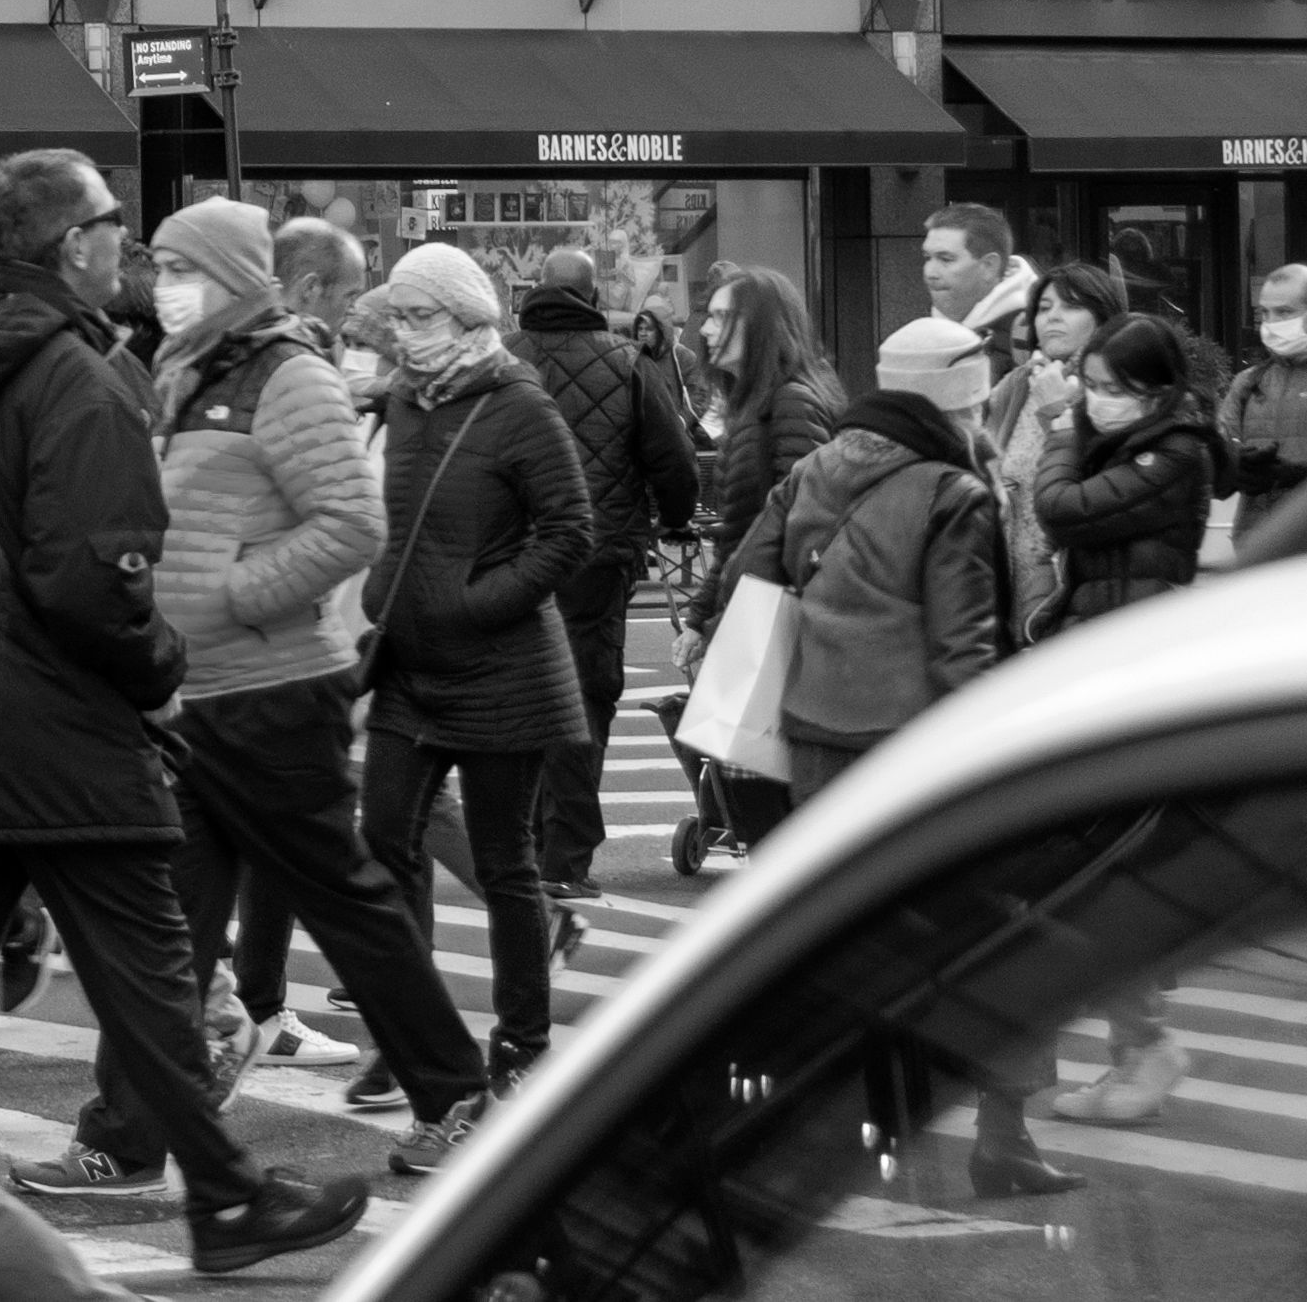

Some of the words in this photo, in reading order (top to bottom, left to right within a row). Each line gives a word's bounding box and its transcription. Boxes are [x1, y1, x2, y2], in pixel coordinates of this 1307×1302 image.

[136, 42, 149, 53] NO
[150, 39, 192, 53] STANDING
[137, 53, 173, 67] Anytime
[538, 133, 683, 162] BARNES&NOBLE
